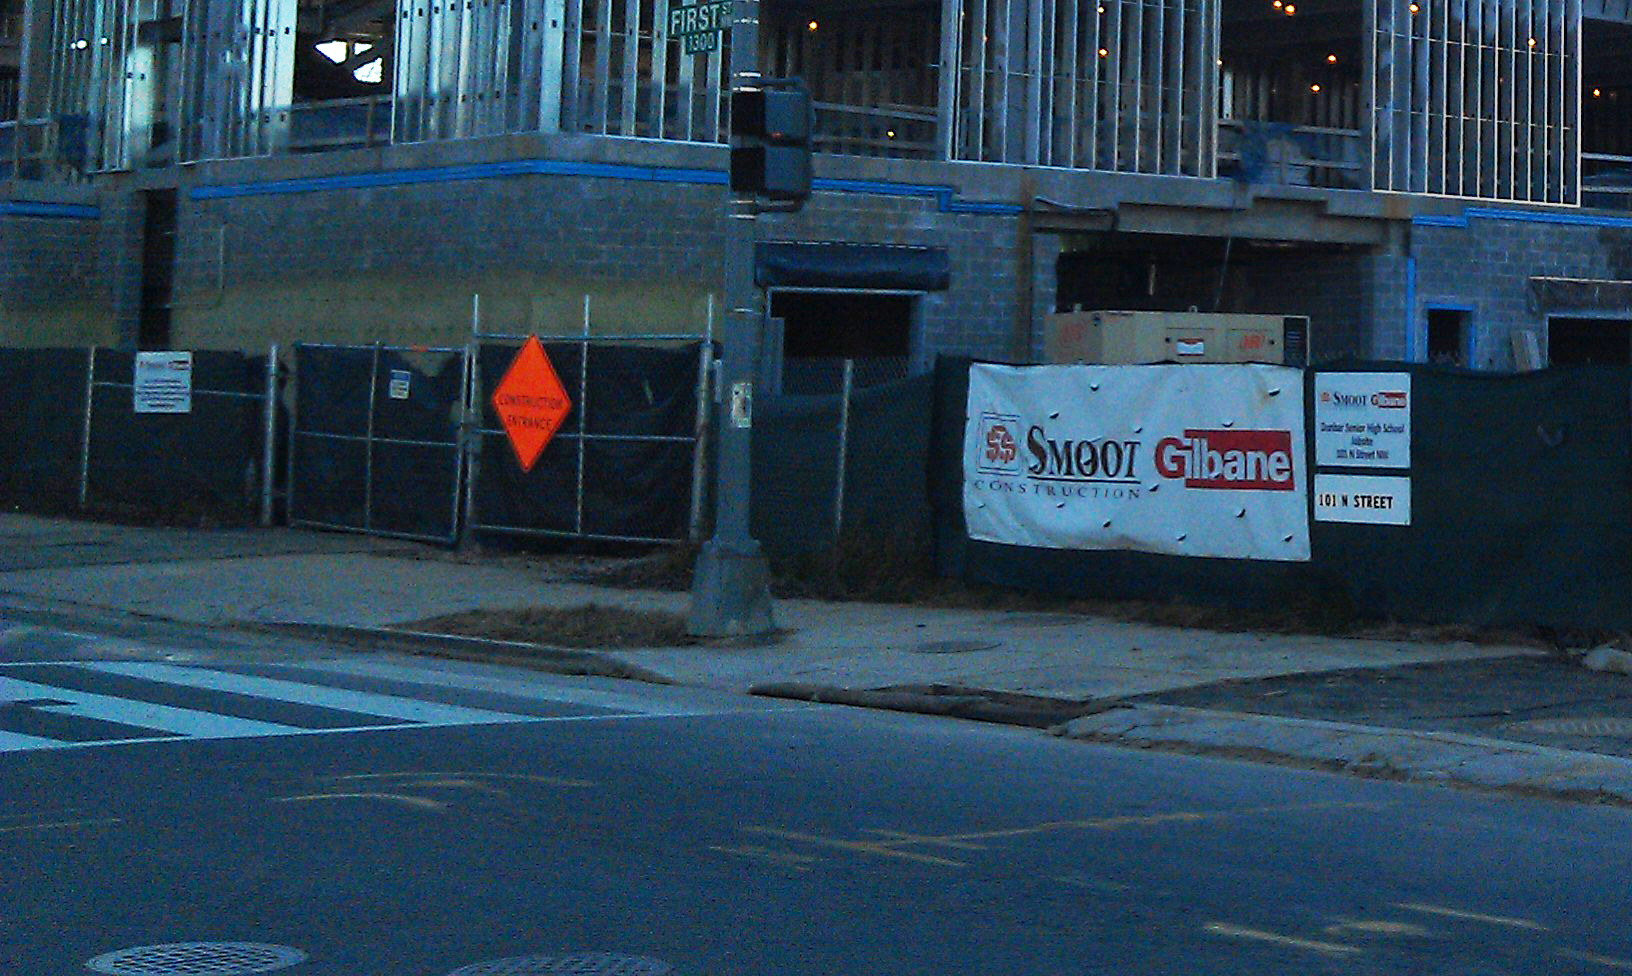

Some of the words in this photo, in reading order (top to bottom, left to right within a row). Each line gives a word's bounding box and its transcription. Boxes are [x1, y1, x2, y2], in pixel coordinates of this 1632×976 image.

[671, 4, 720, 34] FIRST
[1333, 390, 1367, 407] SMOOT
[1027, 425, 1141, 478] SMOOT
[1154, 435, 1292, 483] Gilbane
[973, 479, 1141, 499] CONSTRUCTION
[1319, 494, 1337, 506] 101
[1341, 495, 1348, 506] N
[1354, 495, 1393, 509] STREET
